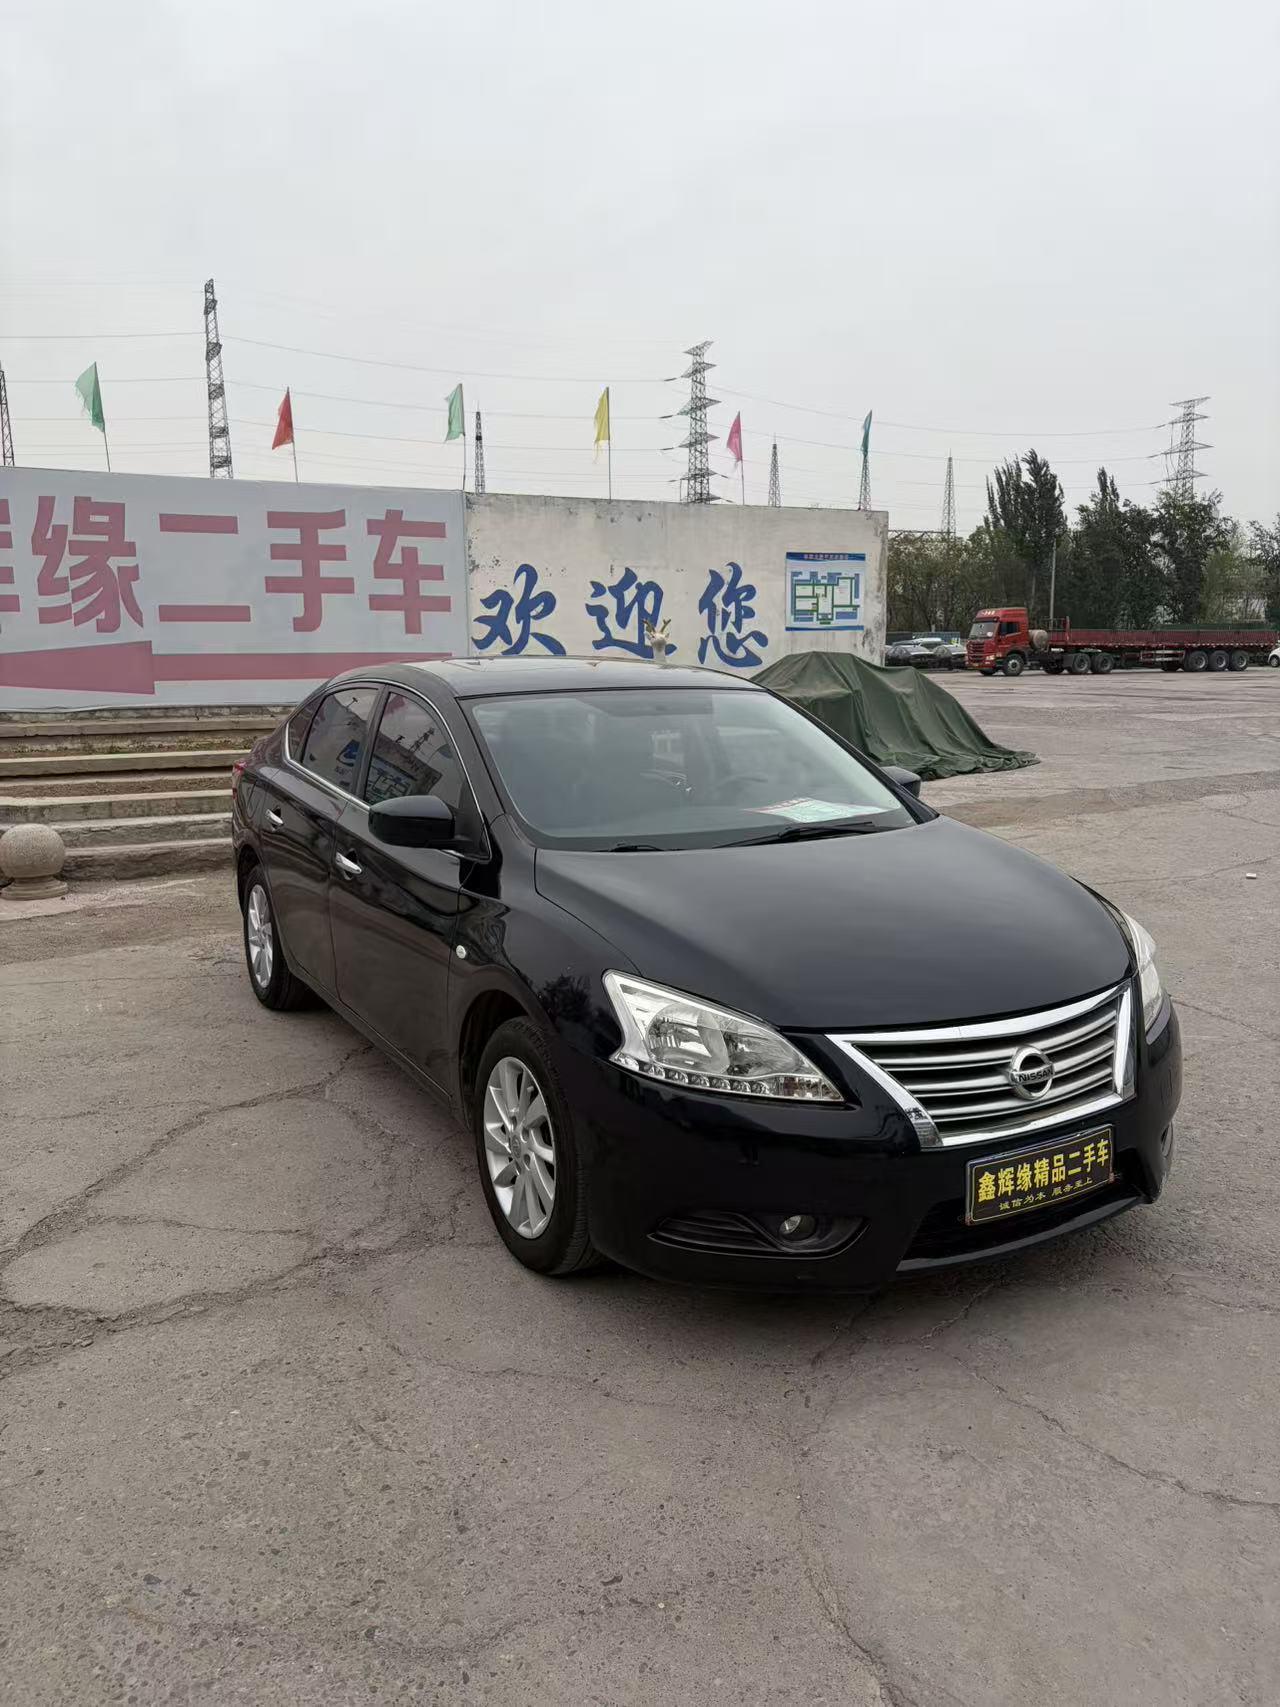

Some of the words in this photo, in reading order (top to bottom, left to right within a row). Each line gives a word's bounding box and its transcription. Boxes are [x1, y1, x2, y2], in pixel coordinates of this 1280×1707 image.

[471, 562, 768, 667] 欢迎您
[1019, 1069, 1053, 1082] NISSAN
[978, 1138, 1110, 1203] 鑫辉缘精品二手车
